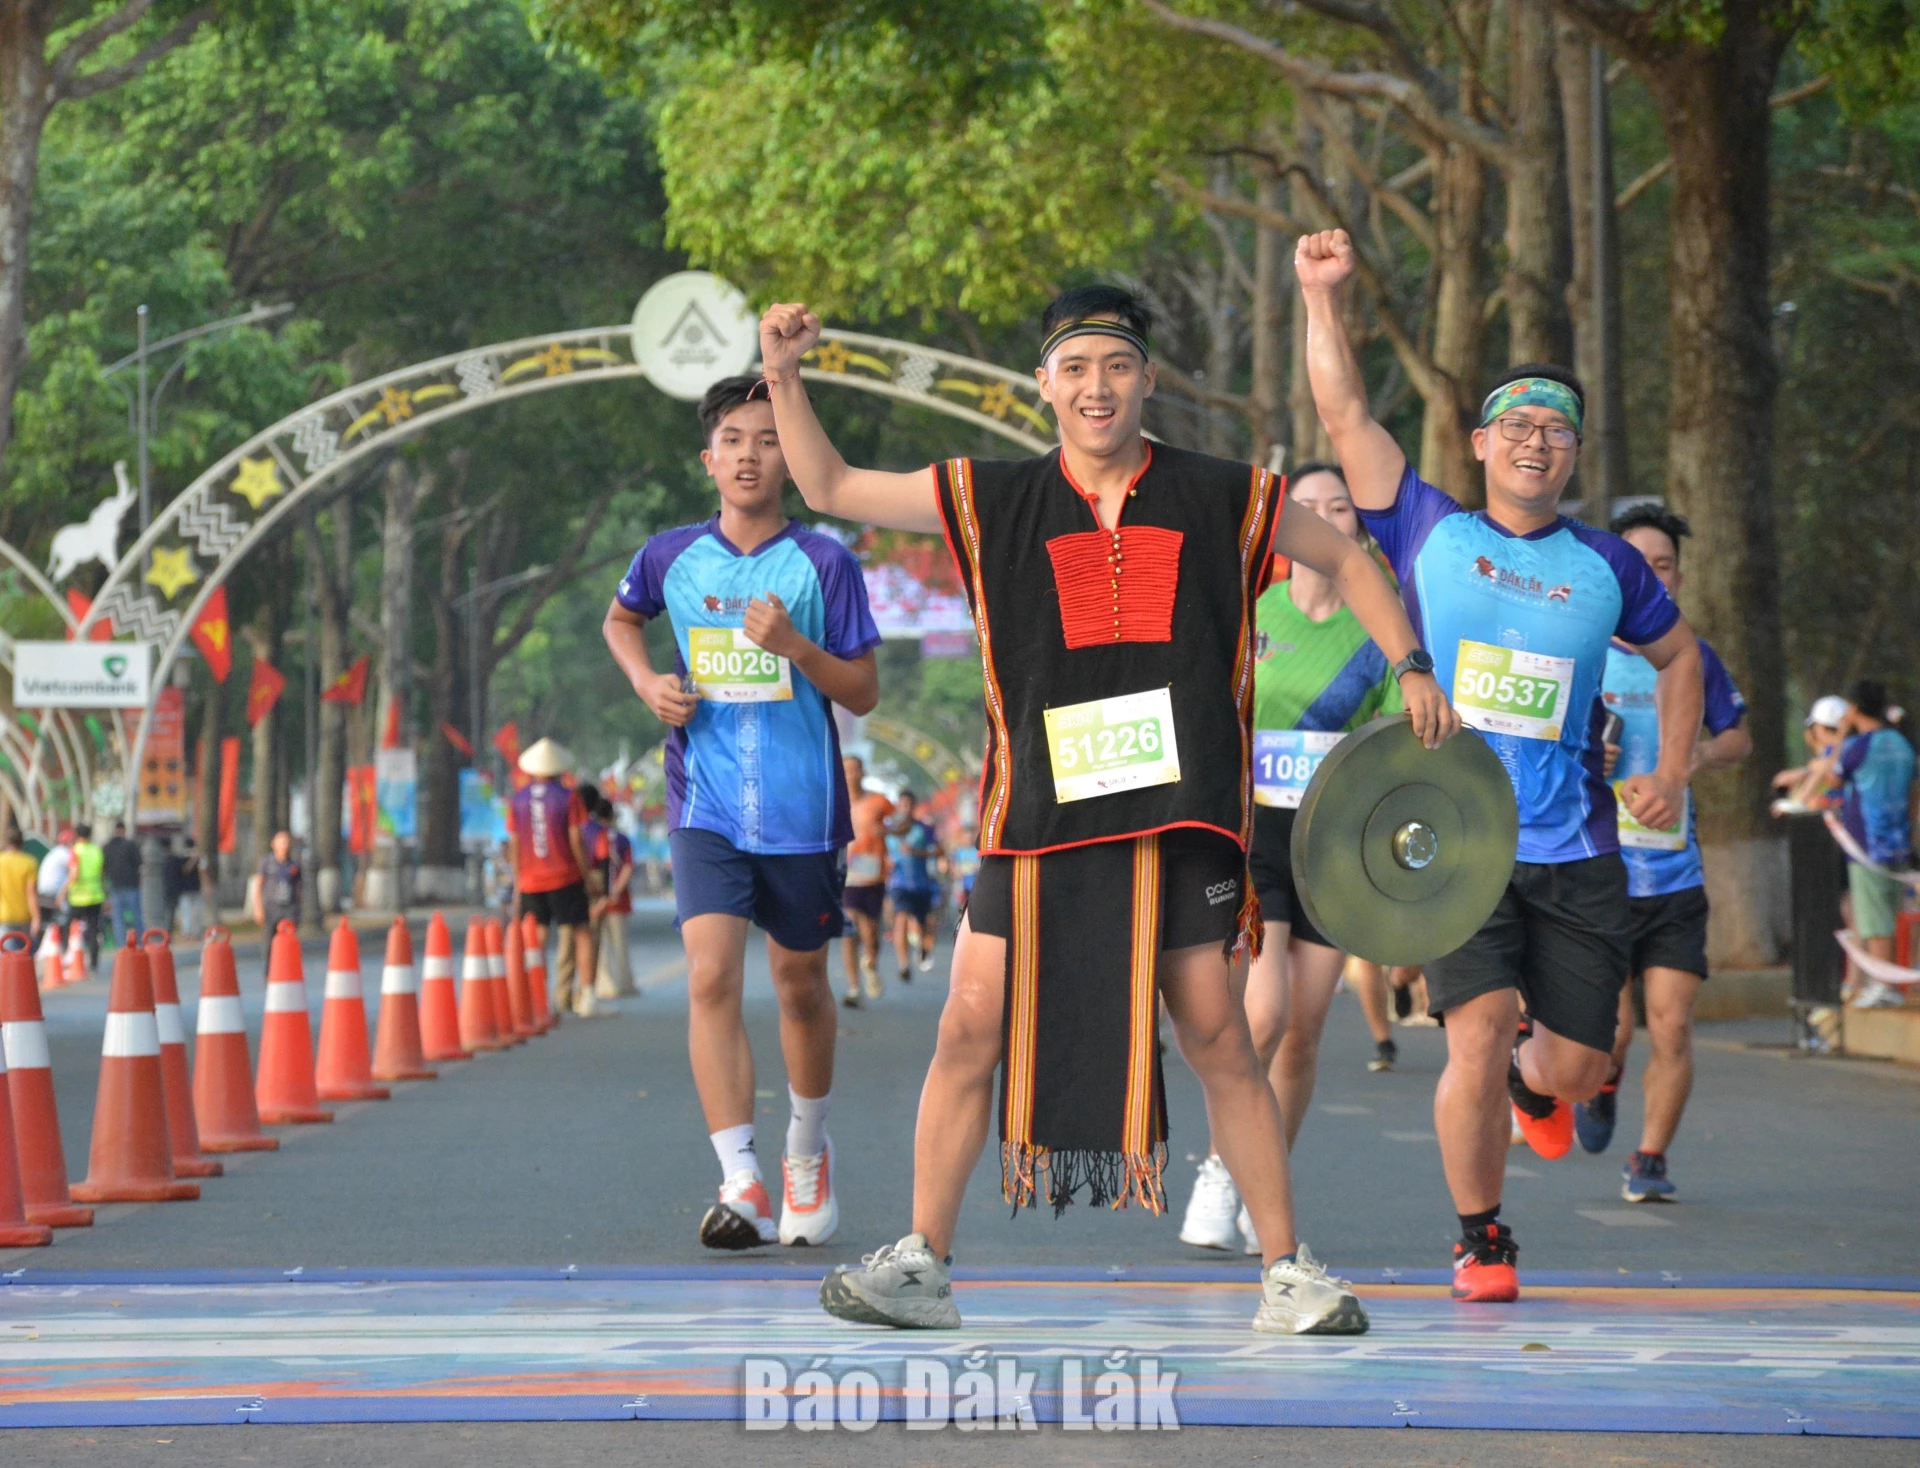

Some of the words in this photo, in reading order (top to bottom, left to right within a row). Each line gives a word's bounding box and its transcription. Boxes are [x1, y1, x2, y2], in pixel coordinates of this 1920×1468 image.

[696, 651, 777, 676] 50026
[22, 678, 138, 696] Vietcombank
[1459, 668, 1556, 709] 50537
[1058, 722, 1160, 769] 51226
